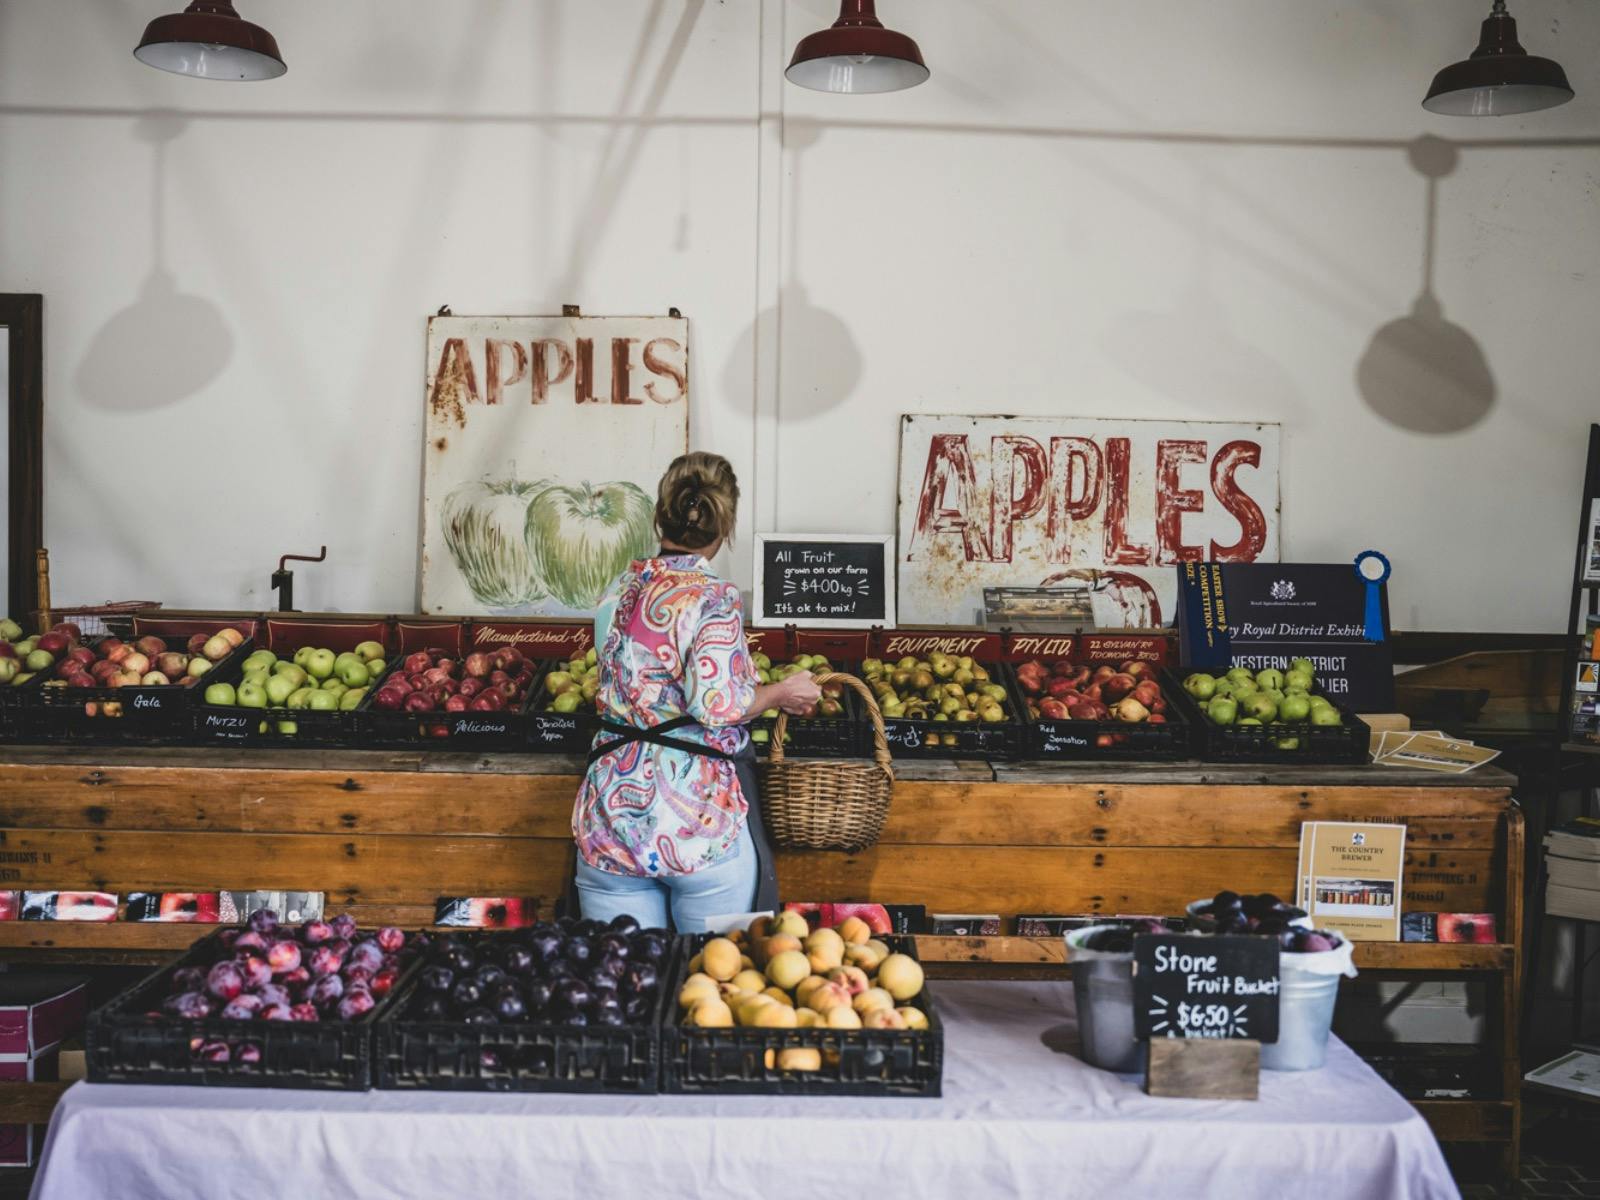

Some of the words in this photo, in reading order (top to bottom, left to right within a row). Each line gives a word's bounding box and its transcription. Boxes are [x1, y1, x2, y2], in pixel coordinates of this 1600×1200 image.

[430, 337, 685, 405] APPLES
[906, 434, 1267, 568] APPLES
[775, 551, 791, 563] All
[801, 550, 836, 563] Fruit
[784, 568, 811, 579] grown
[813, 567, 825, 575] on
[828, 567, 843, 575] our
[846, 564, 868, 575] farm
[1212, 564, 1223, 597] EASTER
[774, 602, 793, 614] It's
[797, 603, 811, 613] ok
[815, 602, 828, 613] to
[831, 601, 856, 613] mix!
[1199, 564, 1214, 629] COMPETITION
[1215, 599, 1226, 624] SHOW
[475, 626, 568, 647] Manufactured
[571, 628, 590, 650] by
[1243, 623, 1276, 639] Royal
[1279, 623, 1323, 636] District
[886, 637, 986, 654] EQUIPMENT
[133, 694, 160, 708] Gala
[1155, 945, 1217, 972] Stone
[1187, 974, 1231, 994] Fruit
